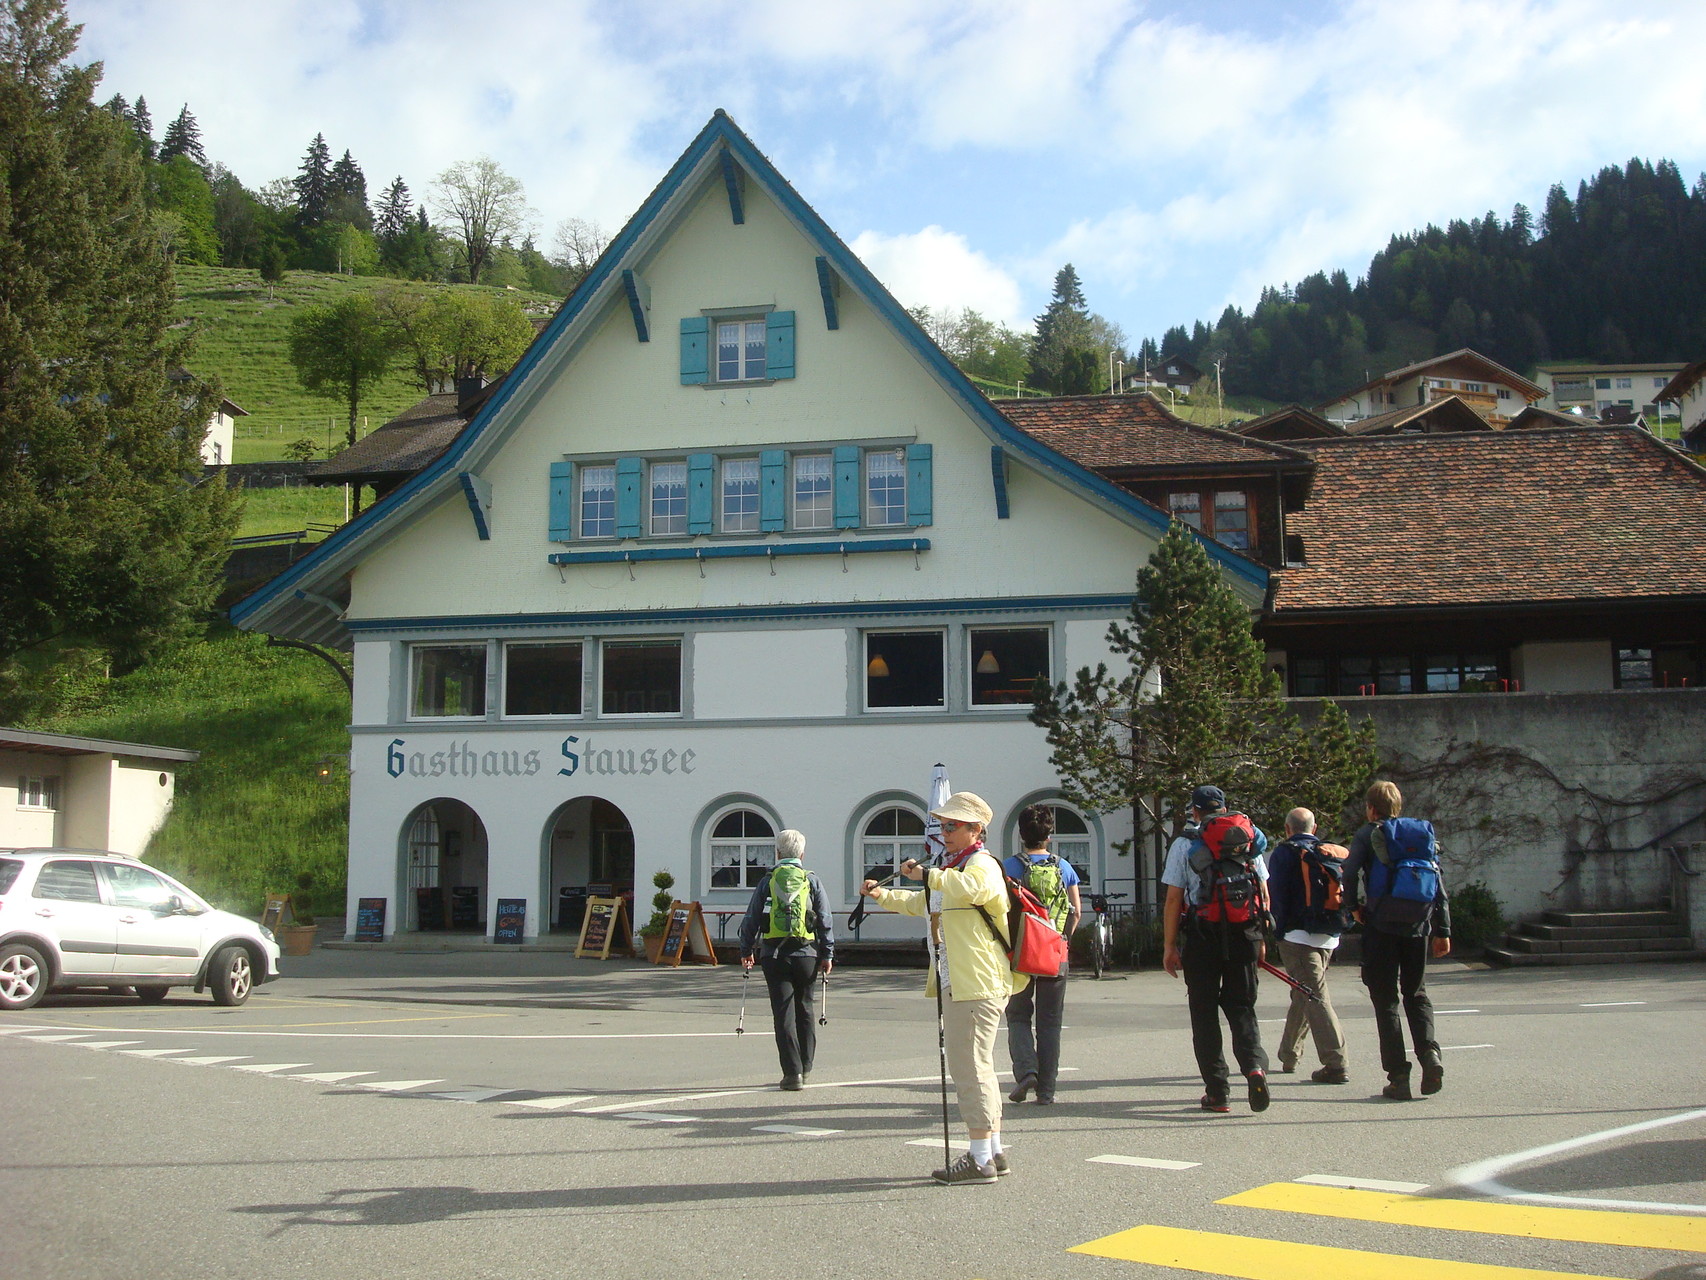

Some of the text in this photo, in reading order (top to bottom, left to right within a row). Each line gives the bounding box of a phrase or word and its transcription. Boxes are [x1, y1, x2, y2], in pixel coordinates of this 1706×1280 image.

[387, 735, 697, 779] Gasthaus Stausee
[498, 929, 517, 938] OFFEN
